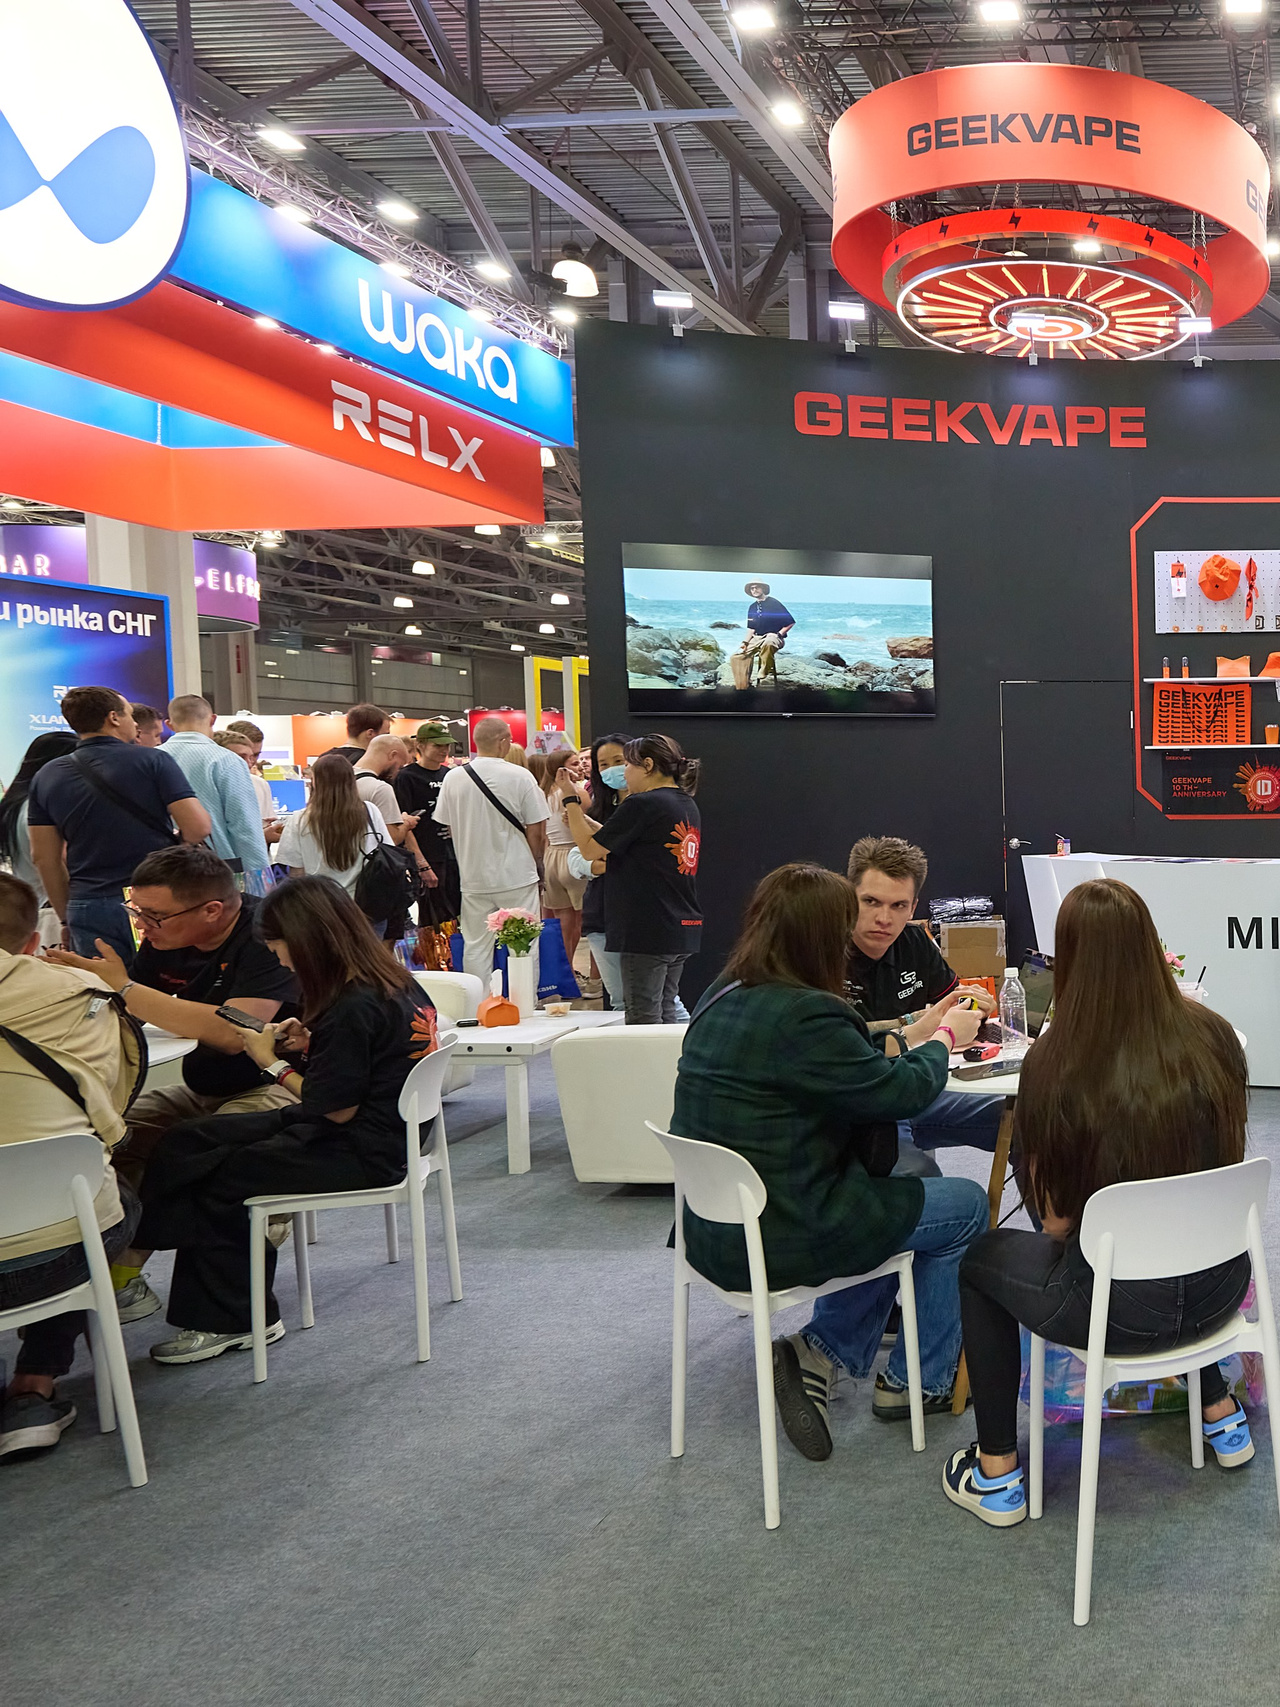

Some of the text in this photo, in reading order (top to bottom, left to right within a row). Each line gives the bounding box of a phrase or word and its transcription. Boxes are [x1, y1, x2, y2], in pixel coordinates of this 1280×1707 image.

[907, 112, 1141, 157] GEEKVAPE
[331, 379, 487, 482] RELX
[794, 391, 1148, 449] GEEKVAPE
[108, 609, 157, 637] СНГ
[1159, 689, 1245, 702] GEEKVAPE
